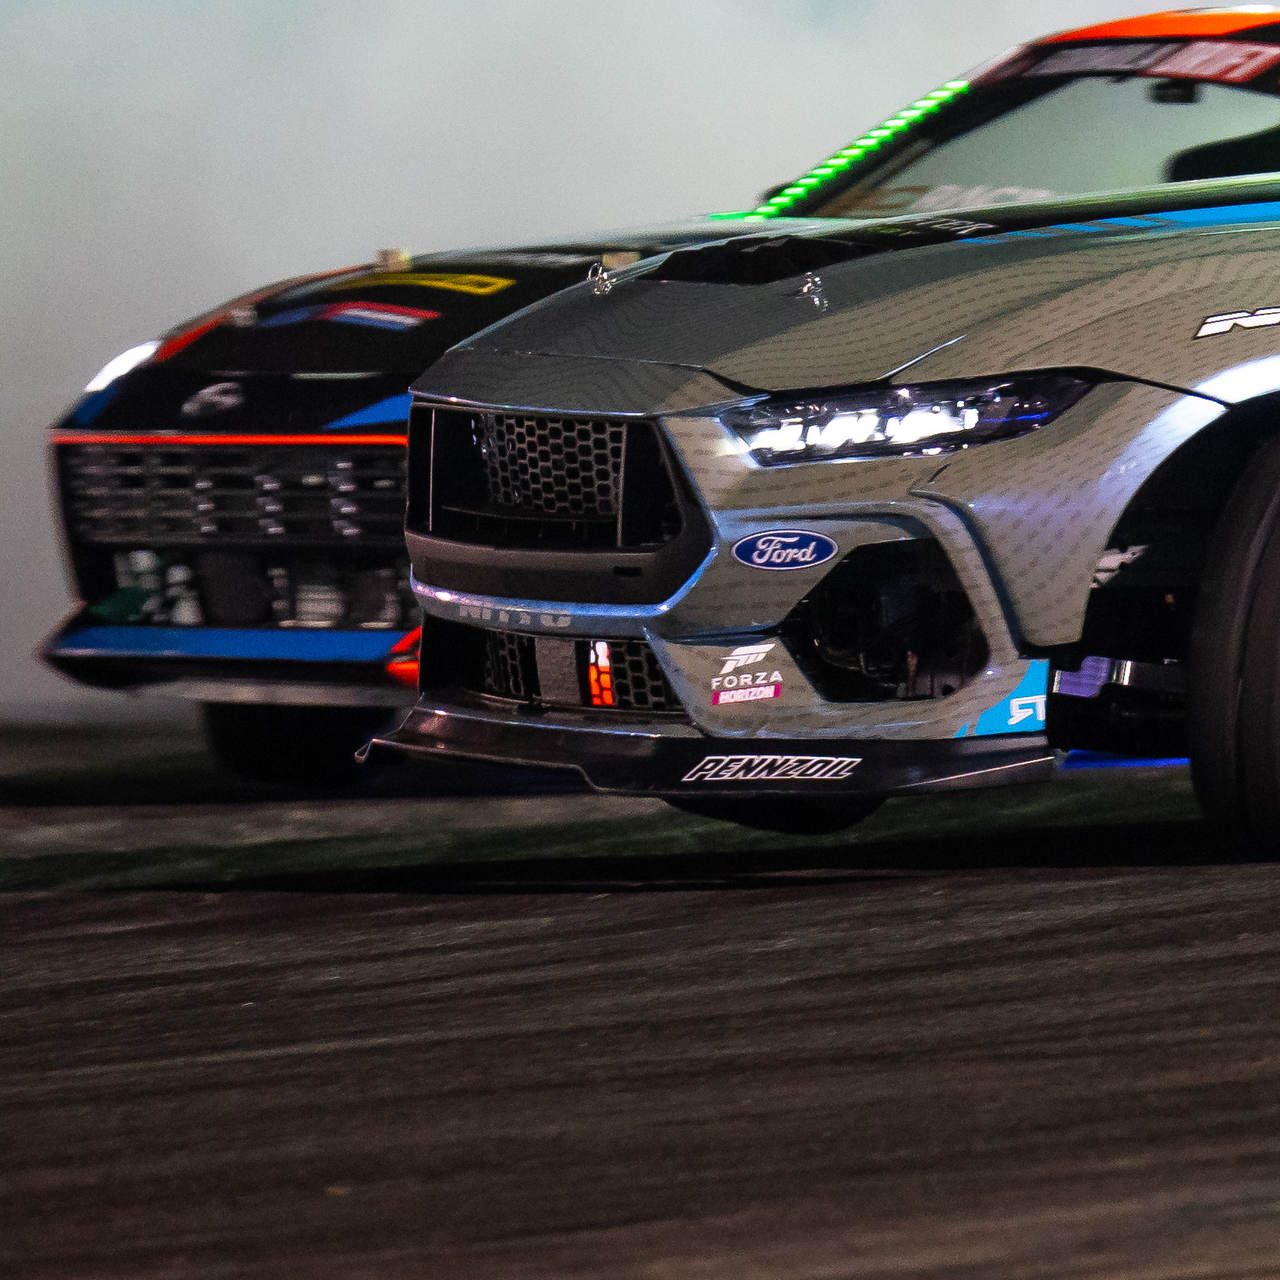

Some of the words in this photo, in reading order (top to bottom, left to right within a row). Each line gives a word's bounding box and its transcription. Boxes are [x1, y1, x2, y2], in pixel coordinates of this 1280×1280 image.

[752, 535, 817, 564] Ford
[711, 670, 784, 690] FORZA
[681, 755, 864, 782] PENNZOIL
